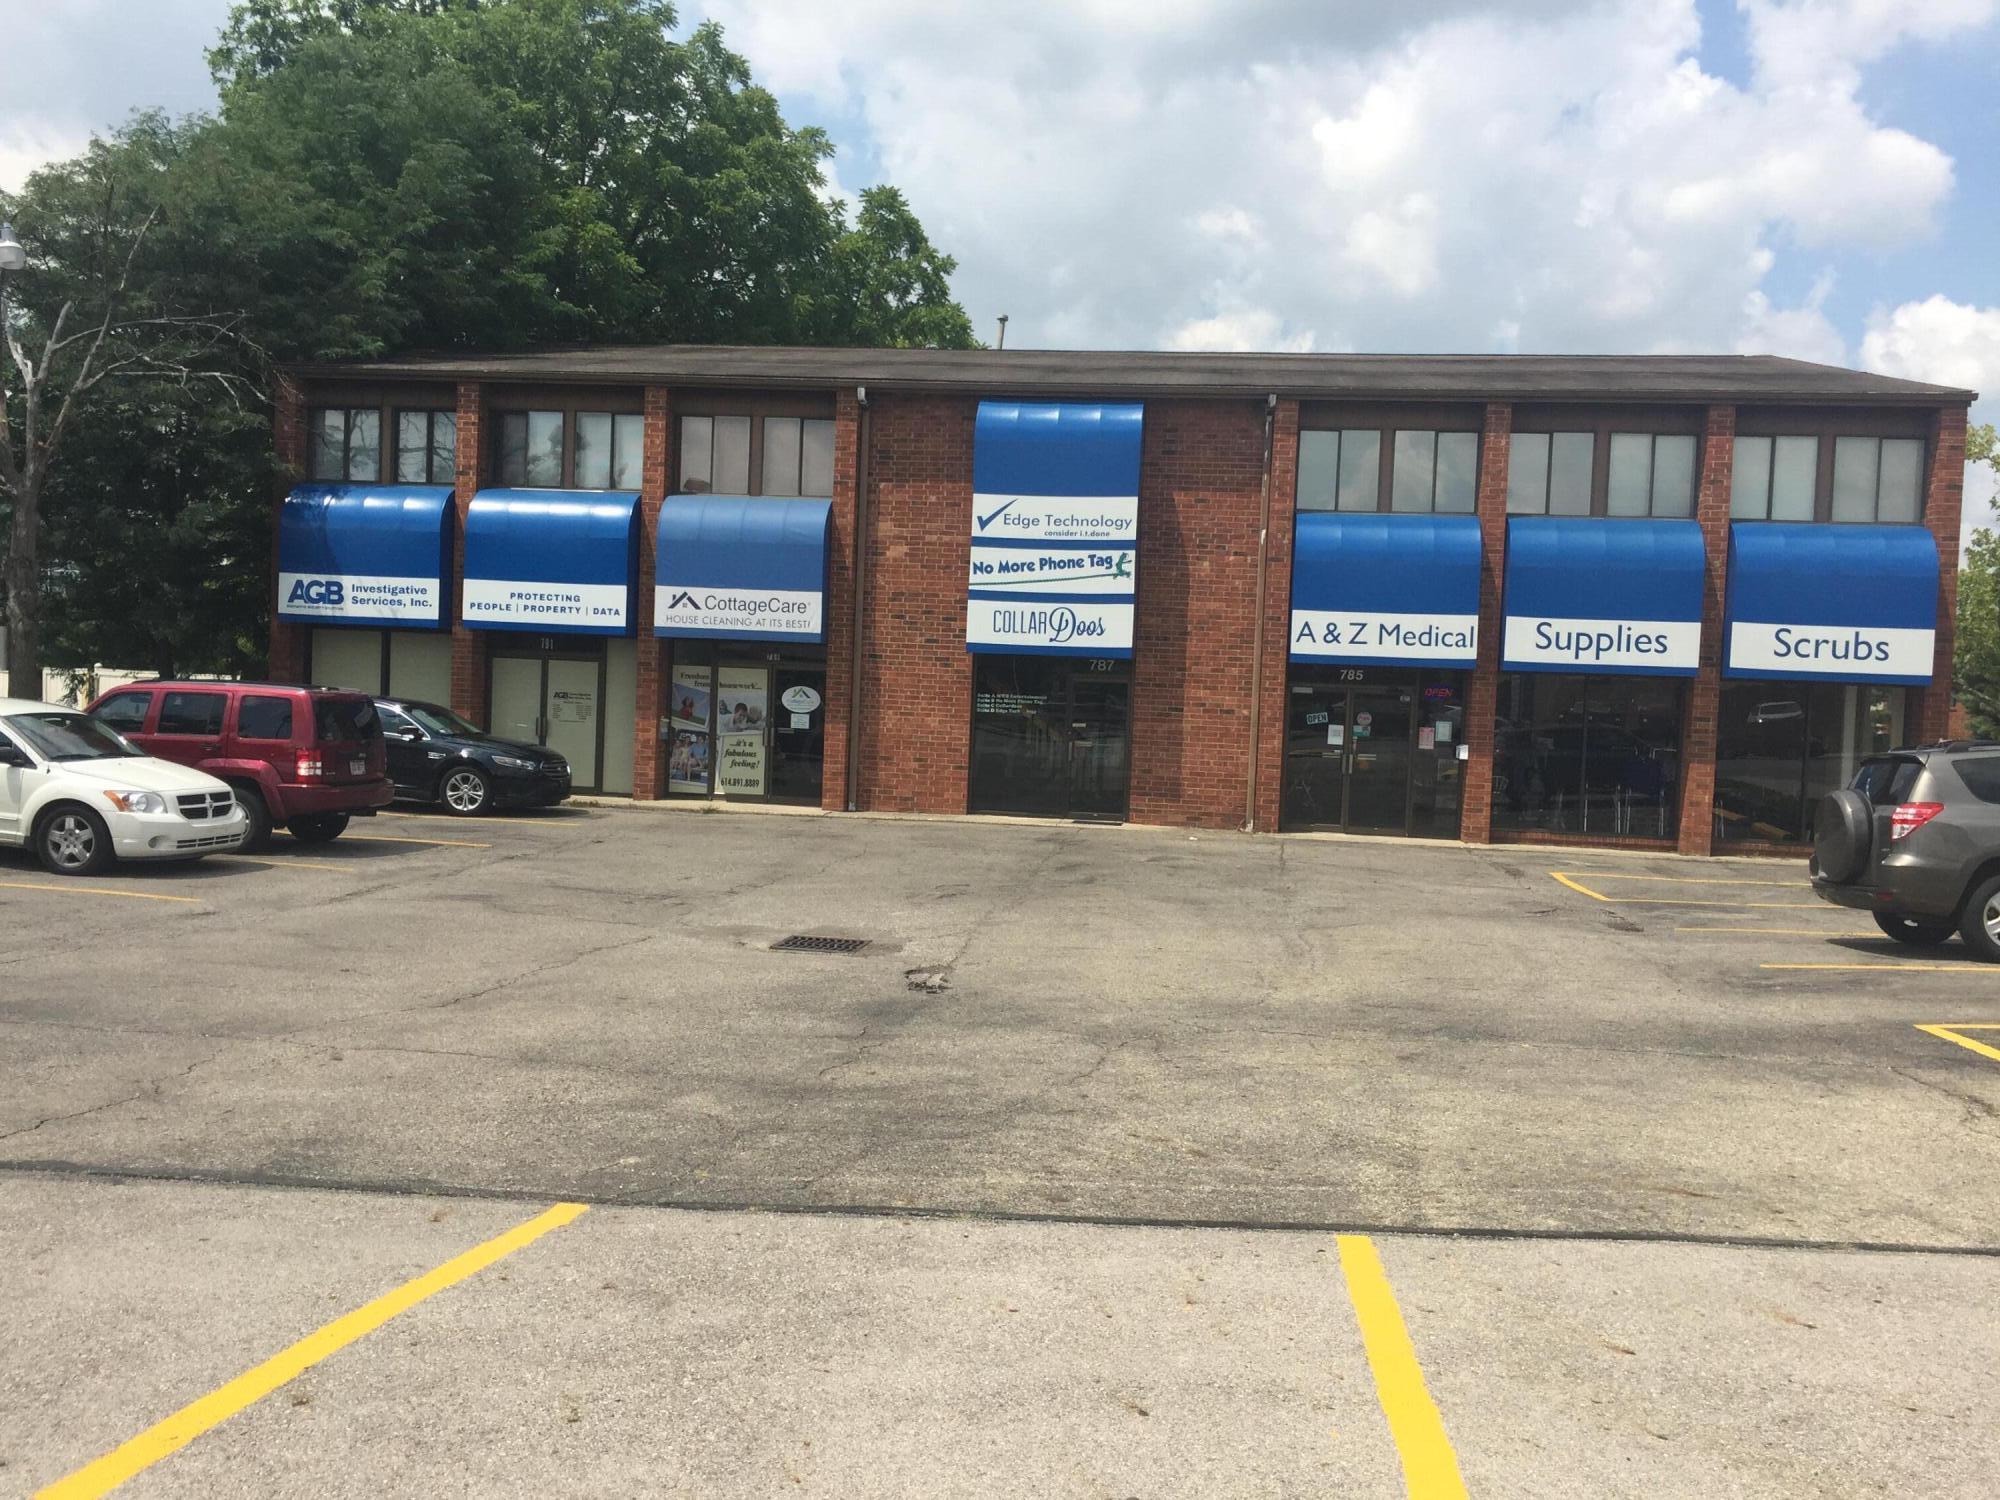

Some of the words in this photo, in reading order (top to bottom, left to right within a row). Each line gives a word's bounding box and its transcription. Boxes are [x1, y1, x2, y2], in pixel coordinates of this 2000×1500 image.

[1003, 513, 1040, 529] Edge
[1045, 514, 1132, 530] Technology
[973, 561, 994, 575] No
[998, 560, 1035, 574] More
[1039, 556, 1085, 571] Phone
[1088, 553, 1113, 570] Tag
[288, 579, 344, 605] AGB
[352, 584, 427, 597] Investigative
[510, 592, 581, 602] PROTECTING
[352, 596, 406, 608] Services,
[410, 598, 432, 607] Inc.
[704, 595, 807, 616] CottageCare
[470, 602, 512, 612] PEOPLE
[523, 604, 581, 614] PROPERTY
[593, 607, 620, 616] DATA
[666, 615, 699, 625] HOUSE
[702, 616, 752, 627] CLEANING
[755, 618, 767, 627] AT
[770, 619, 782, 628] ITS
[785, 619, 811, 629] BEST!
[1296, 620, 1316, 643] A
[1323, 622, 1341, 644] &
[1349, 622, 1368, 645] Z
[1378, 623, 1474, 648] Medical
[1535, 621, 1668, 661] Supplies
[1773, 627, 1890, 662] Scrubs
[1089, 659, 1115, 671] 787
[1340, 669, 1364, 680] 785
[1424, 688, 1453, 696] OPEN
[1308, 713, 1327, 722] OPEN
[724, 748, 757, 758] fabulous
[729, 759, 760, 769] feeling!
